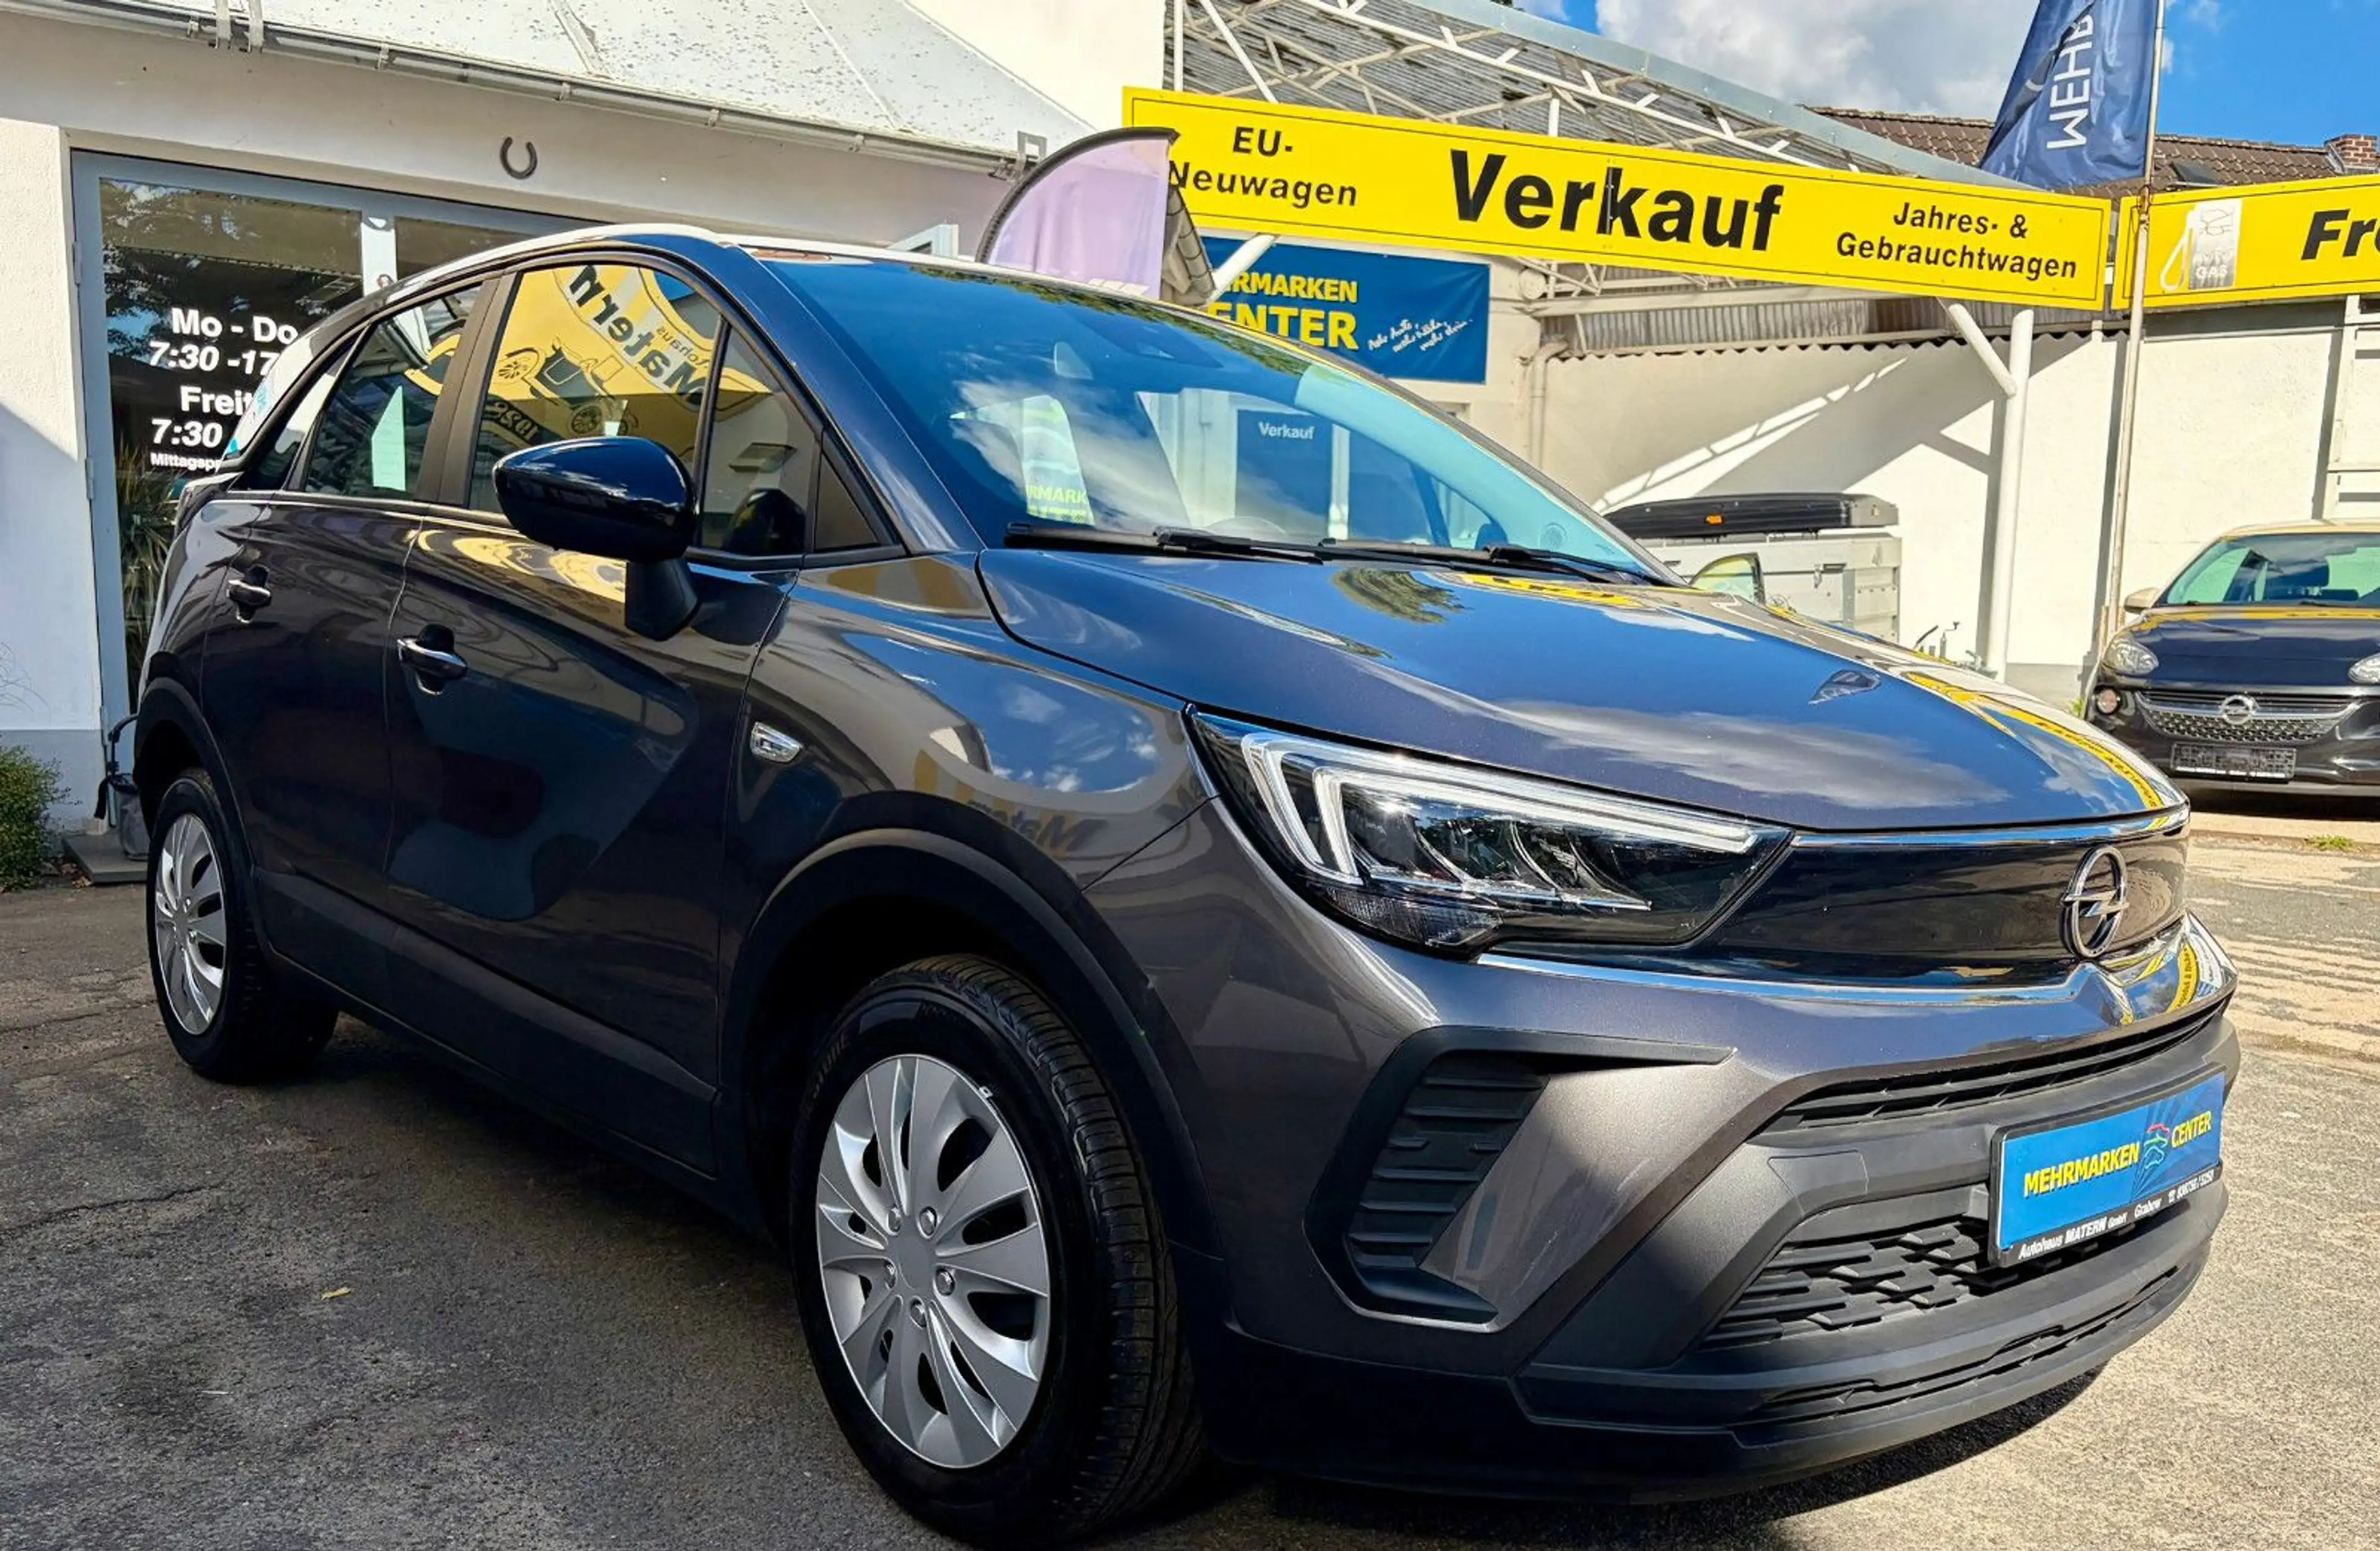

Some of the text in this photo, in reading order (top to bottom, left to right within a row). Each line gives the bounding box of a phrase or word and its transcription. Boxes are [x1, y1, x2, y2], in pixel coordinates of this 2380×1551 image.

[1232, 126, 1293, 157] EU-
[1169, 160, 1357, 208] Neuwagen
[1450, 148, 1784, 252] Verkauf
[1893, 202, 2029, 239] Jahres- &
[2301, 209, 2380, 261] Fr
[1837, 232, 2077, 282] Gebrauchtwagen
[171, 309, 222, 338] Mo
[252, 315, 298, 345] Do
[149, 341, 219, 372] 7:30
[151, 419, 223, 448] 7:30
[1258, 421, 1315, 439] Verkauf
[2023, 1141, 2140, 1198] MEHRMARKEN
[2171, 1111, 2211, 1148] CENTER
[2018, 1236, 2063, 1260] Autohaus
[2065, 1216, 2107, 1245] MATERN
